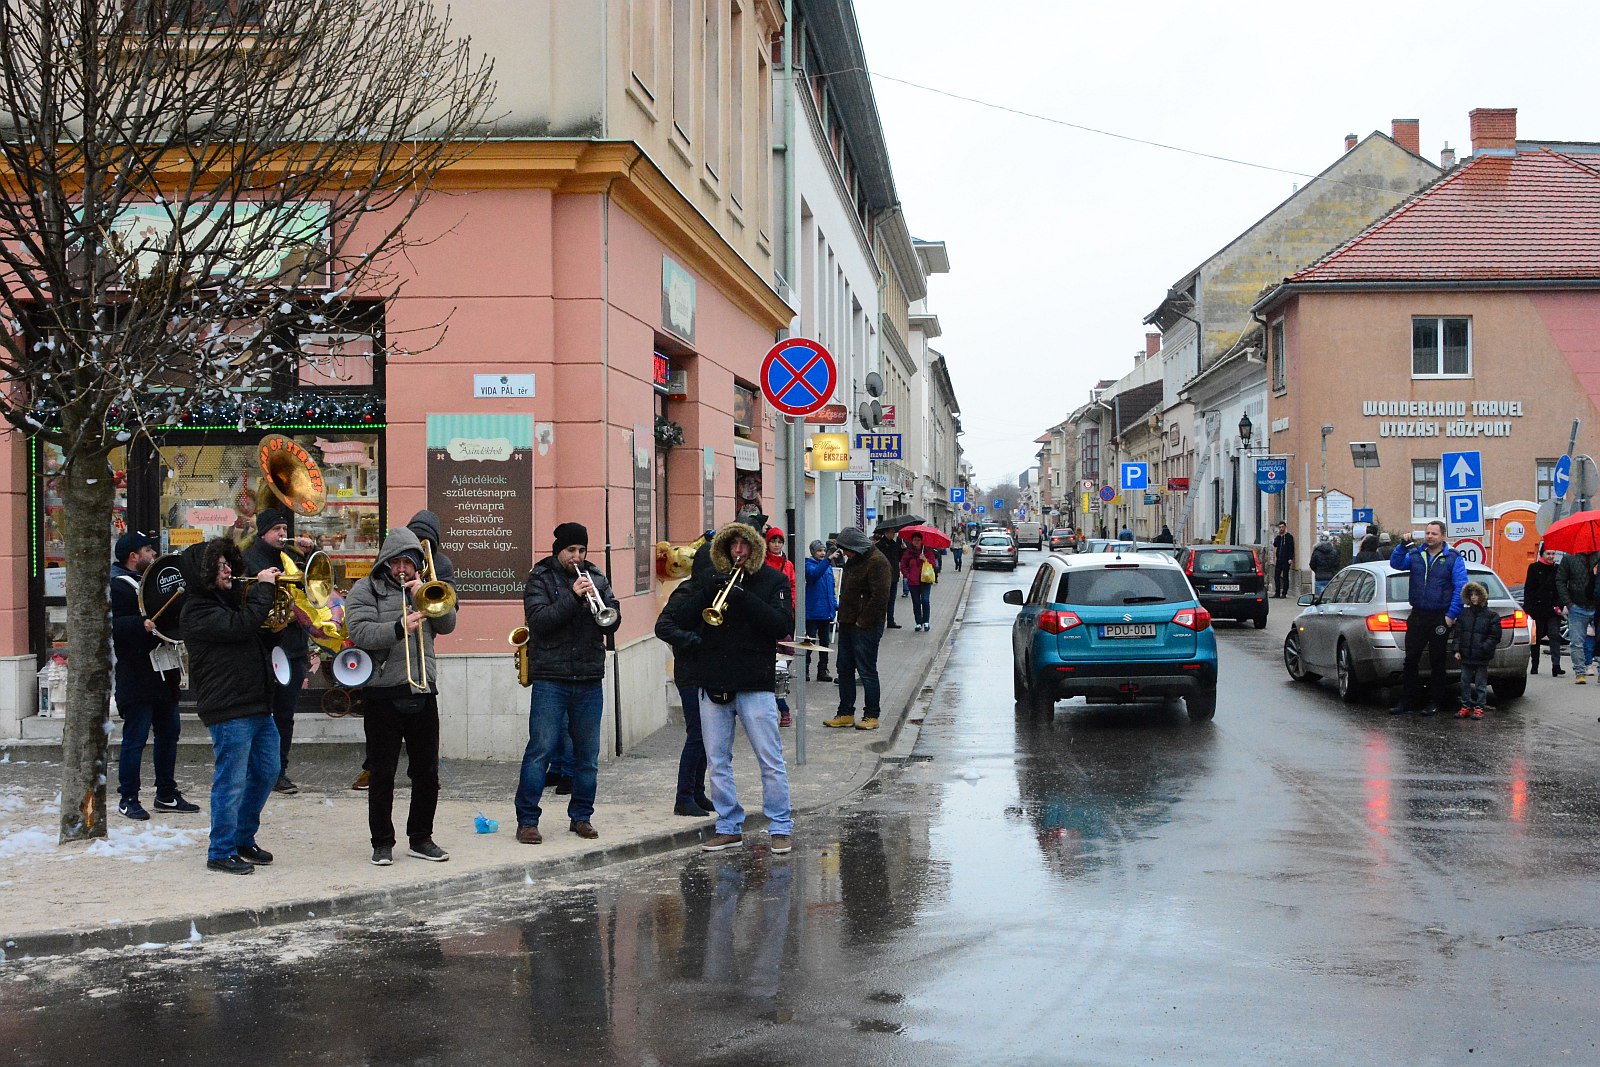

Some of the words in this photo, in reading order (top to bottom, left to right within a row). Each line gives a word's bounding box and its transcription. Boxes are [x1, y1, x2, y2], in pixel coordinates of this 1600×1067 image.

[480, 386, 497, 395] VIDA
[501, 384, 514, 395] PÁL
[518, 386, 528, 395] tér
[1362, 400, 1466, 417] WONDERLAND
[1471, 400, 1524, 417] TRAVEL
[1379, 418, 1440, 437] UTAZÁSI
[1446, 418, 1512, 437] KÖZPONT
[860, 435, 899, 451] FIFI
[823, 453, 848, 461] ÉKSZER
[870, 450, 898, 458] nzváltó
[269, 438, 283, 451] OF
[287, 441, 323, 492] STREETS
[451, 475, 507, 486] Ajándékok:
[1127, 466, 1142, 487] P
[442, 488, 516, 499] -születésnapra
[953, 490, 962, 502] P
[454, 501, 505, 512] -névnapra
[1455, 498, 1473, 520] P
[455, 514, 504, 523] -esküvőre
[1358, 511, 1366, 521] P
[446, 527, 513, 537] -keresztelőre
[1455, 526, 1476, 534] ZÓNA
[441, 542, 465, 551] vagy
[467, 540, 490, 549] csak
[493, 540, 518, 551] úgy...
[453, 568, 515, 579] dekorációk
[1106, 624, 1153, 636] PDU-001
